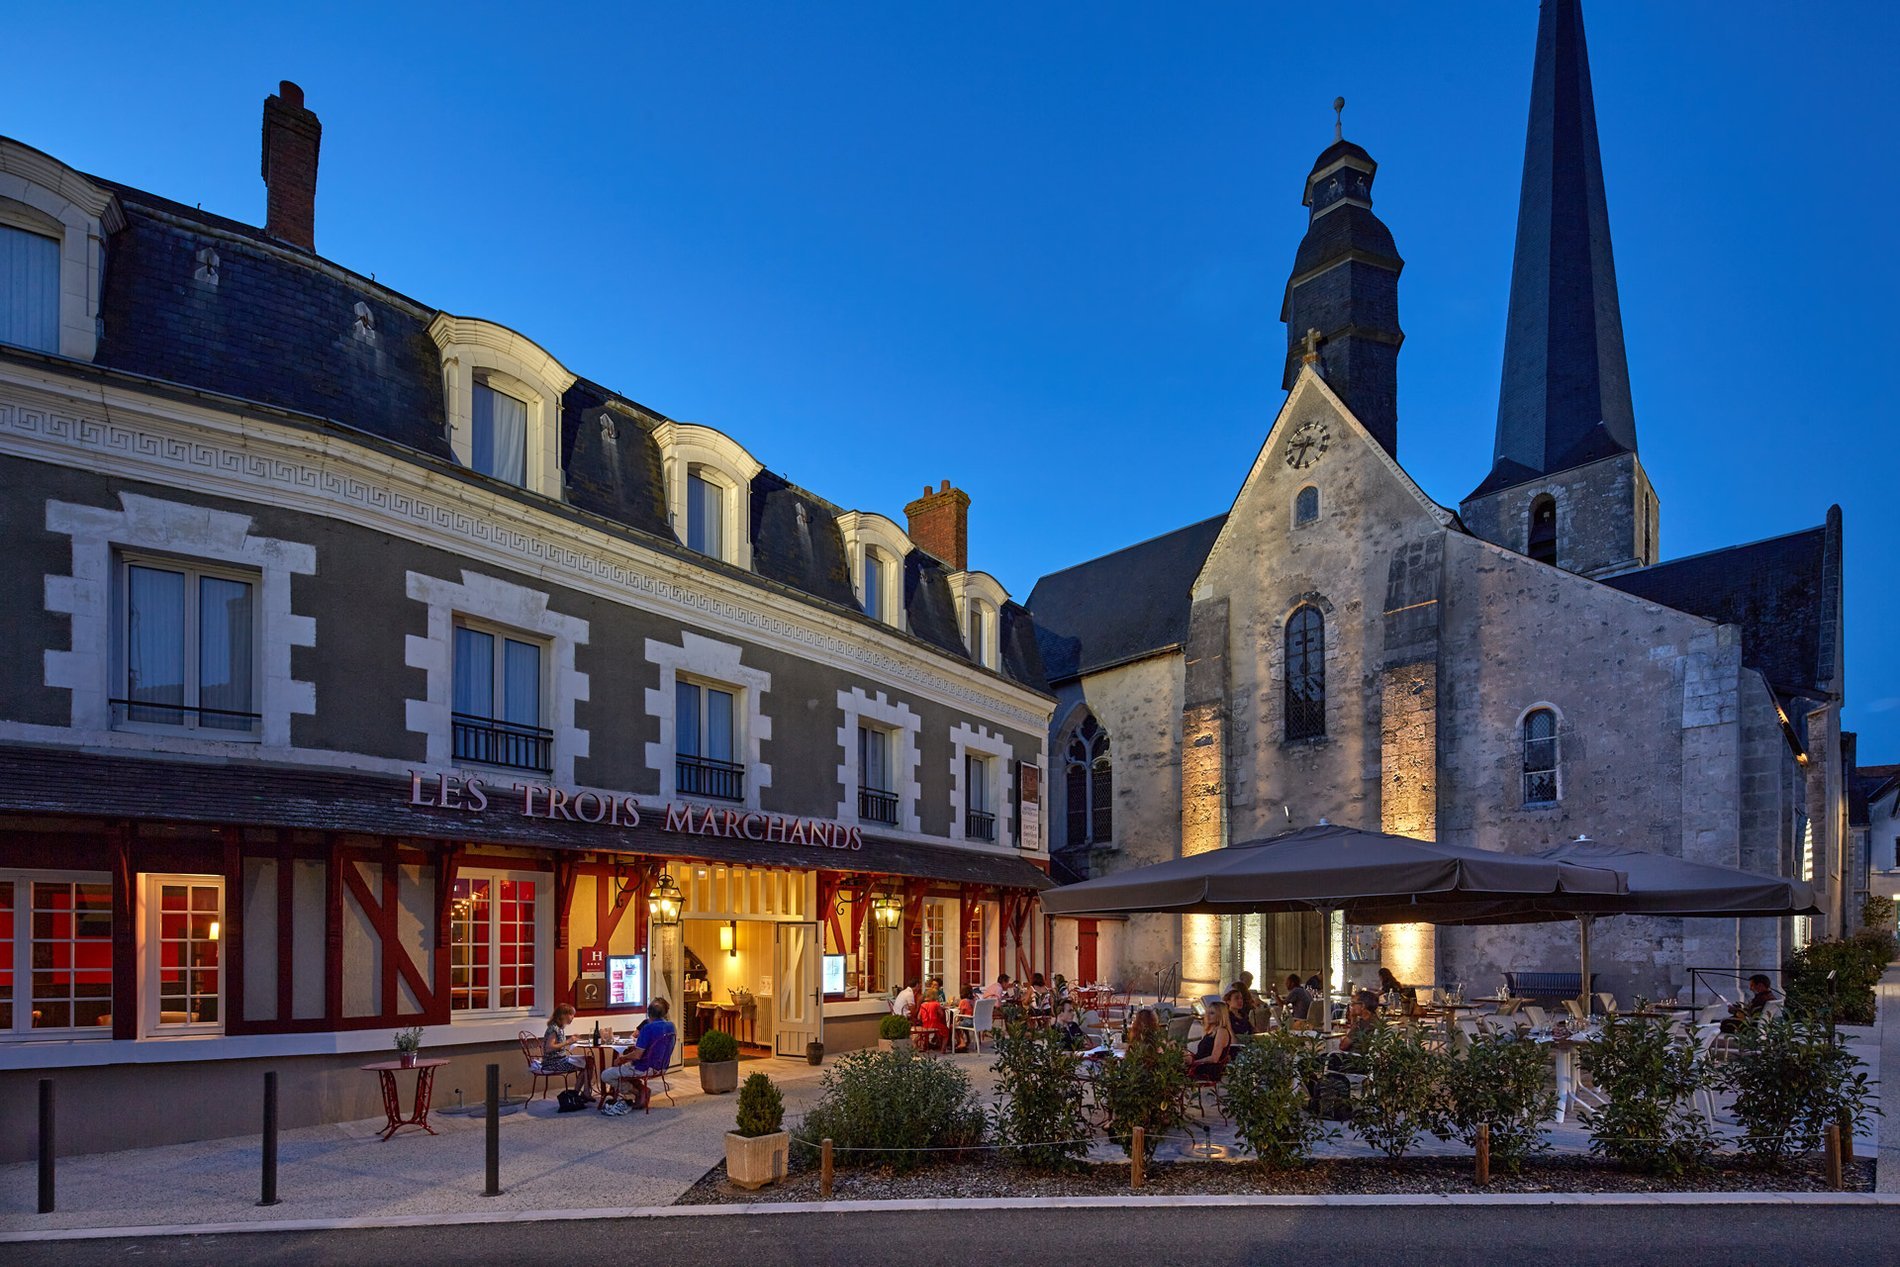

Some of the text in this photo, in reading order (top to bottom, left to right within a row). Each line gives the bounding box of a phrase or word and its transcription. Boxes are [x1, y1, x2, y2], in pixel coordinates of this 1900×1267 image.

[407, 769, 862, 851] LES TROIS MARCHANDS
[592, 951, 602, 961] H
